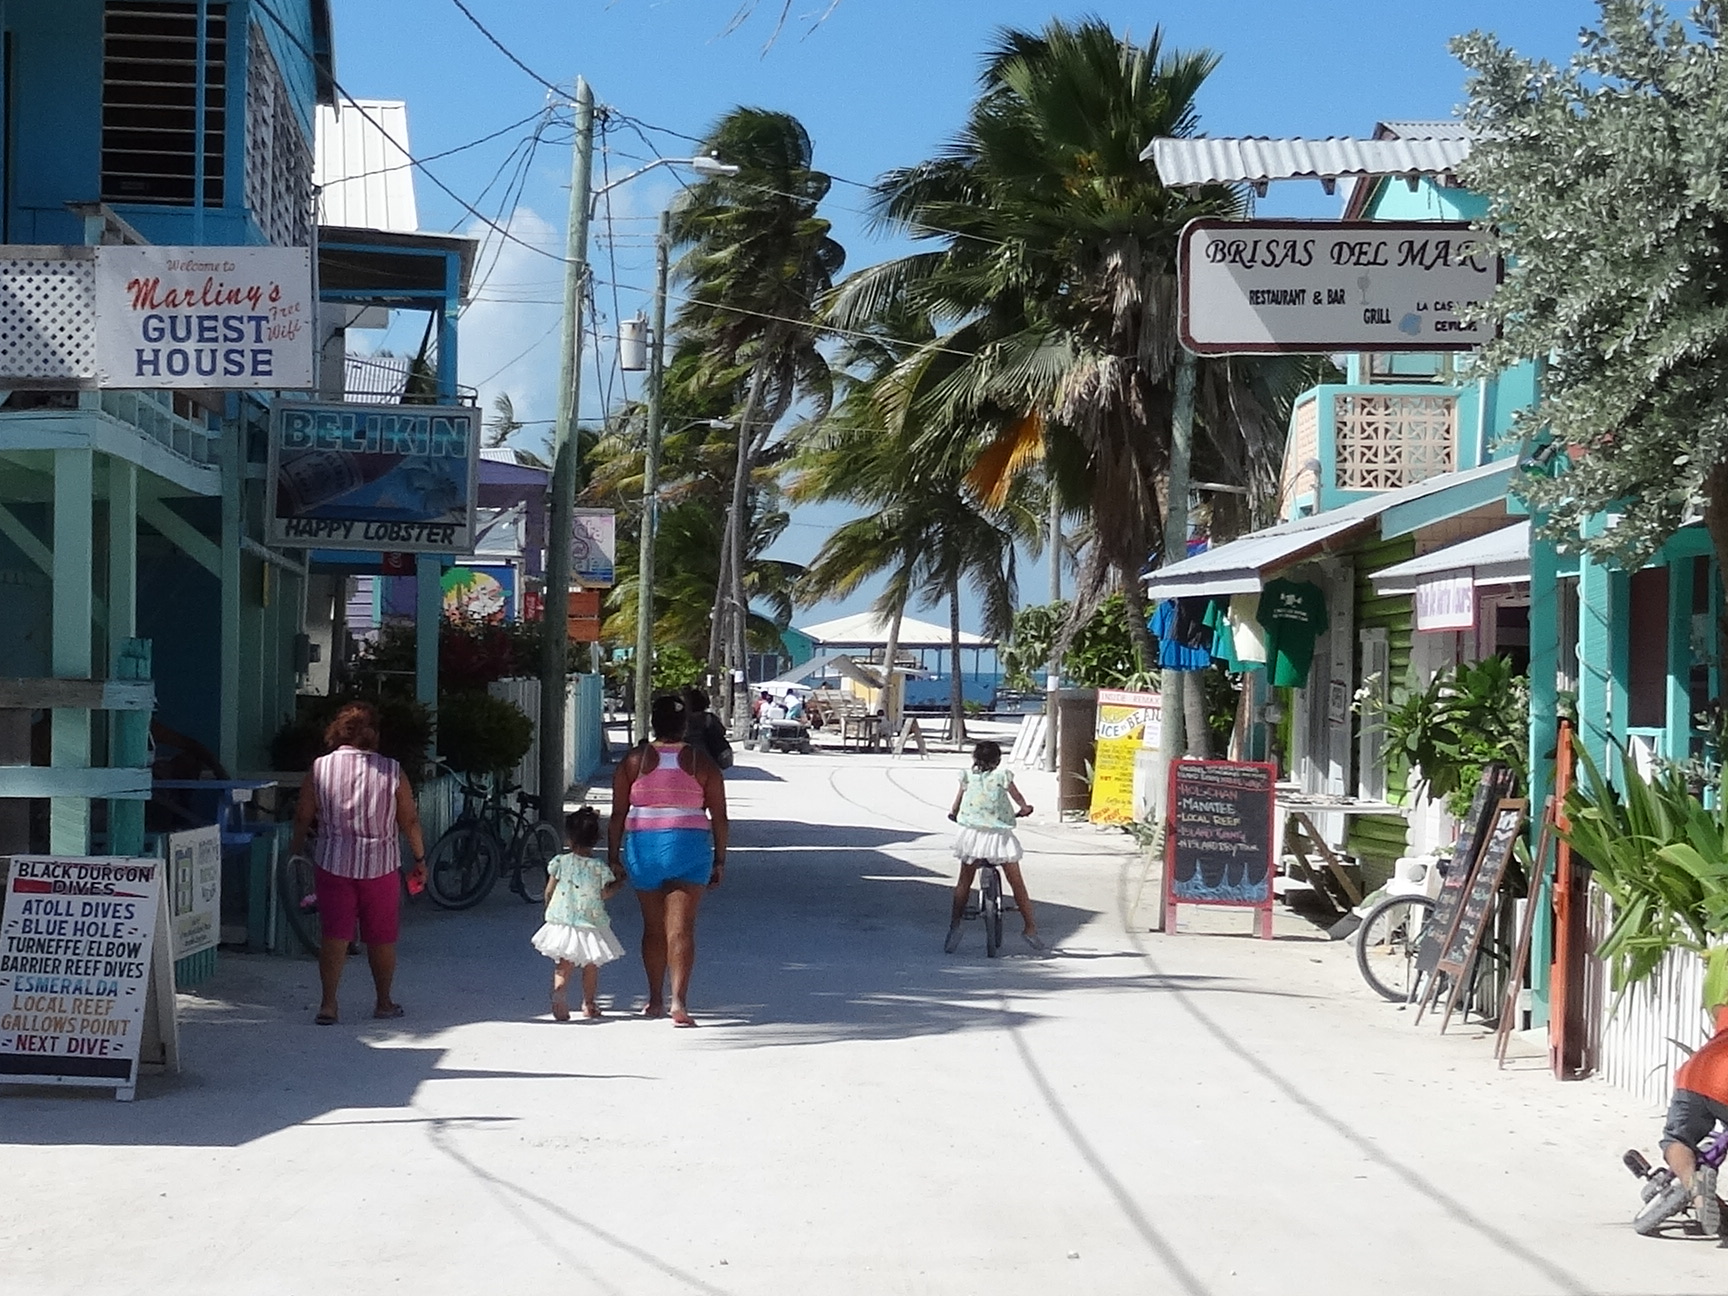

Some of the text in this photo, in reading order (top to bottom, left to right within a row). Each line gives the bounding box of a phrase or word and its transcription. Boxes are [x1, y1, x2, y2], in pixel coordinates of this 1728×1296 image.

[166, 259, 236, 272] Welcome to
[1205, 239, 1488, 273] BRISAS DEL MAR
[126, 276, 282, 311] Marliny's
[1248, 288, 1346, 306] RESTAURANT & BAR
[1363, 306, 1392, 324] GRILL
[1416, 301, 1429, 312] LA
[142, 314, 270, 344] GUEST
[135, 348, 273, 376] HOUSE
[281, 410, 470, 458] BELIKIN
[284, 518, 456, 545] HAPPY LOBSTER
[1101, 723, 1120, 738] ICE
[1182, 798, 1236, 814] MANATEE
[18, 862, 151, 883] BLACK DURGON
[52, 881, 116, 896] DIVES
[22, 898, 136, 920] ATOLL DIVES
[21, 918, 125, 939] BLUE HOLE
[7, 936, 143, 959] TURNEFFE/ELBOW
[0, 955, 144, 979] BARRIER REEF DIVES
[14, 976, 119, 997] ESMERALDA
[12, 995, 116, 1016] LOCAL REEF
[0, 1014, 131, 1036] GALLOWS POINT
[15, 1034, 110, 1055] NEXT DIVE
